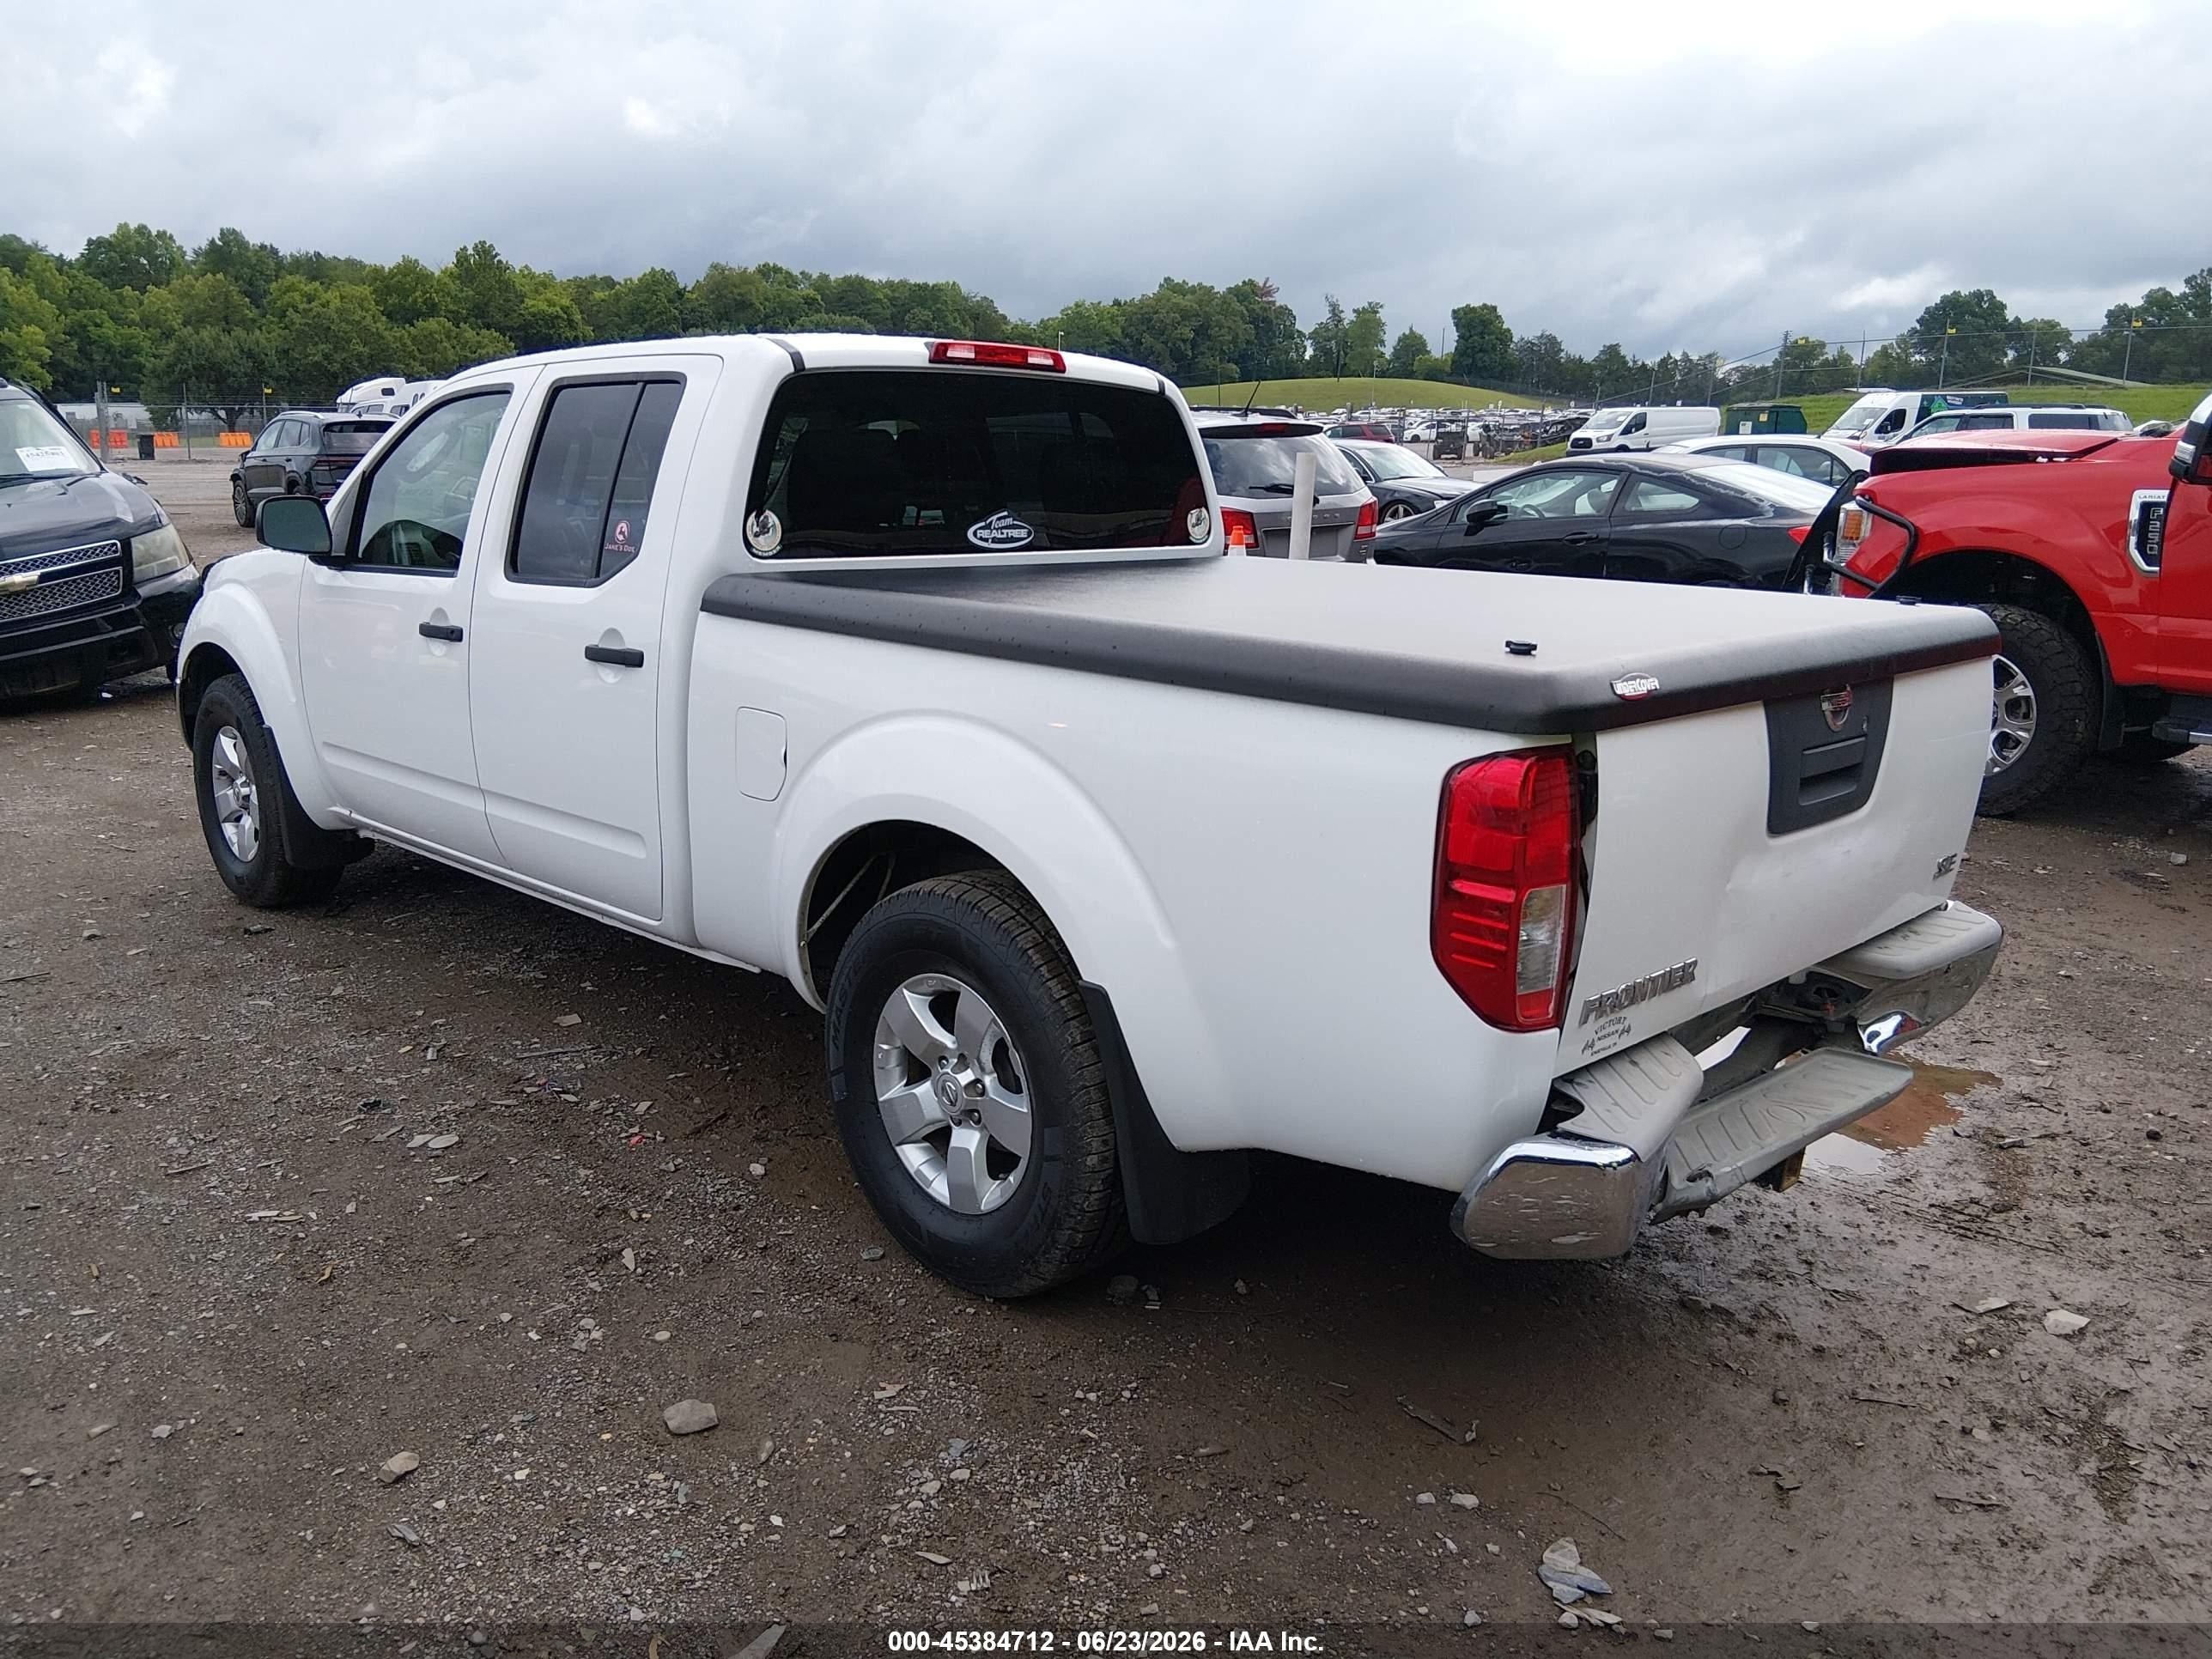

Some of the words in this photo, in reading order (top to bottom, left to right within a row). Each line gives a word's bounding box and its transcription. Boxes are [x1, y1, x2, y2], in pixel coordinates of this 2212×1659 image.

[986, 511, 1013, 530] Team
[976, 529, 1029, 539] REALTREE
[1578, 957, 1698, 1027] FRONTIER
[1595, 1016, 1627, 1036] VICTORY
